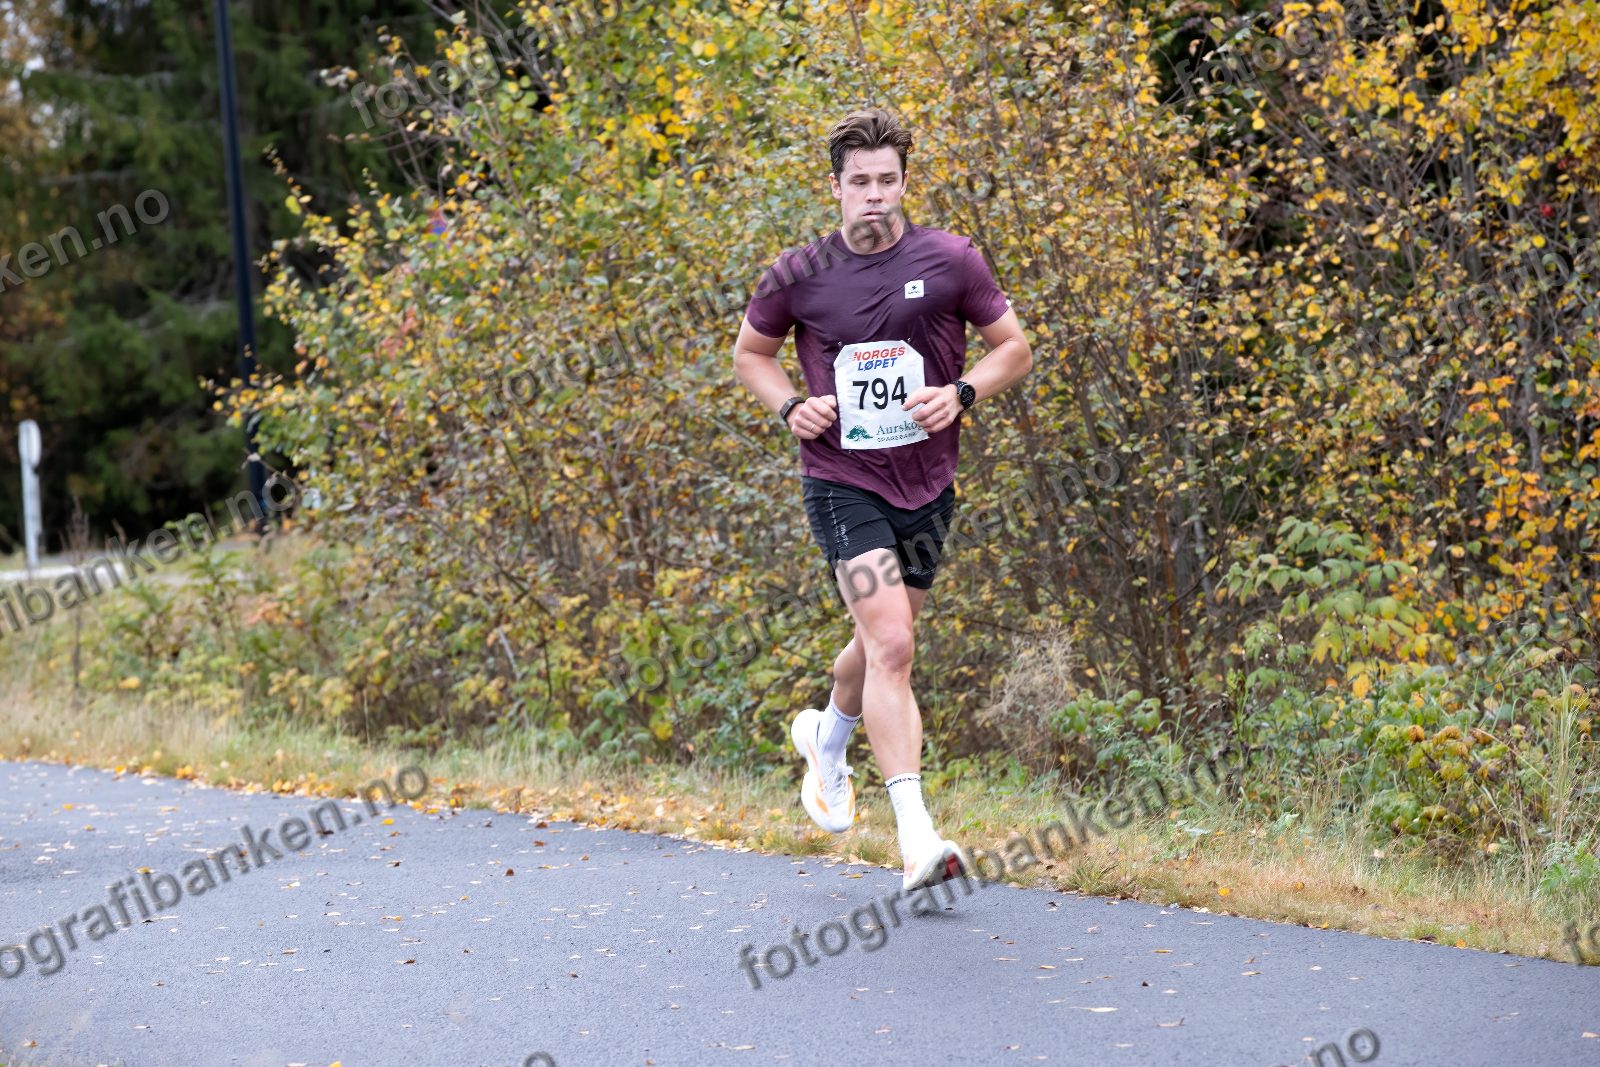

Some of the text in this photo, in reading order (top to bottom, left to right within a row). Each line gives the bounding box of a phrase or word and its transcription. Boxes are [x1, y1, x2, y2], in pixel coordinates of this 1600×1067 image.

[853, 347, 906, 362] NORGES
[857, 357, 898, 371] LØPET
[852, 376, 908, 410] 794
